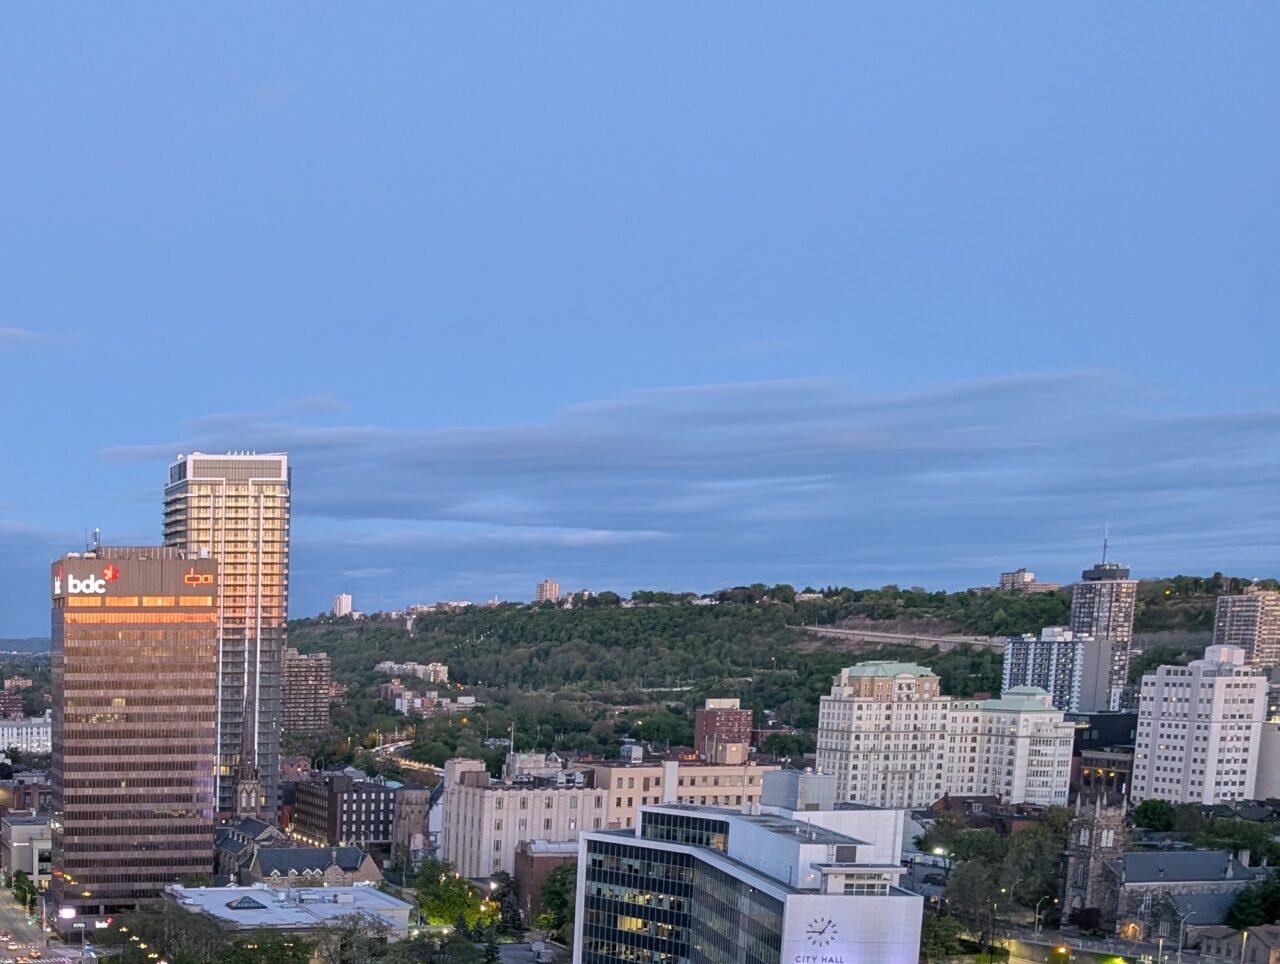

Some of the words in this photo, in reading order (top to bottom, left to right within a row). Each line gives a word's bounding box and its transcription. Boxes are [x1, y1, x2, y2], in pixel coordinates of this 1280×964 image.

[68, 574, 106, 593] bdc
[795, 955, 818, 963] CITY
[821, 956, 845, 964] HALL
